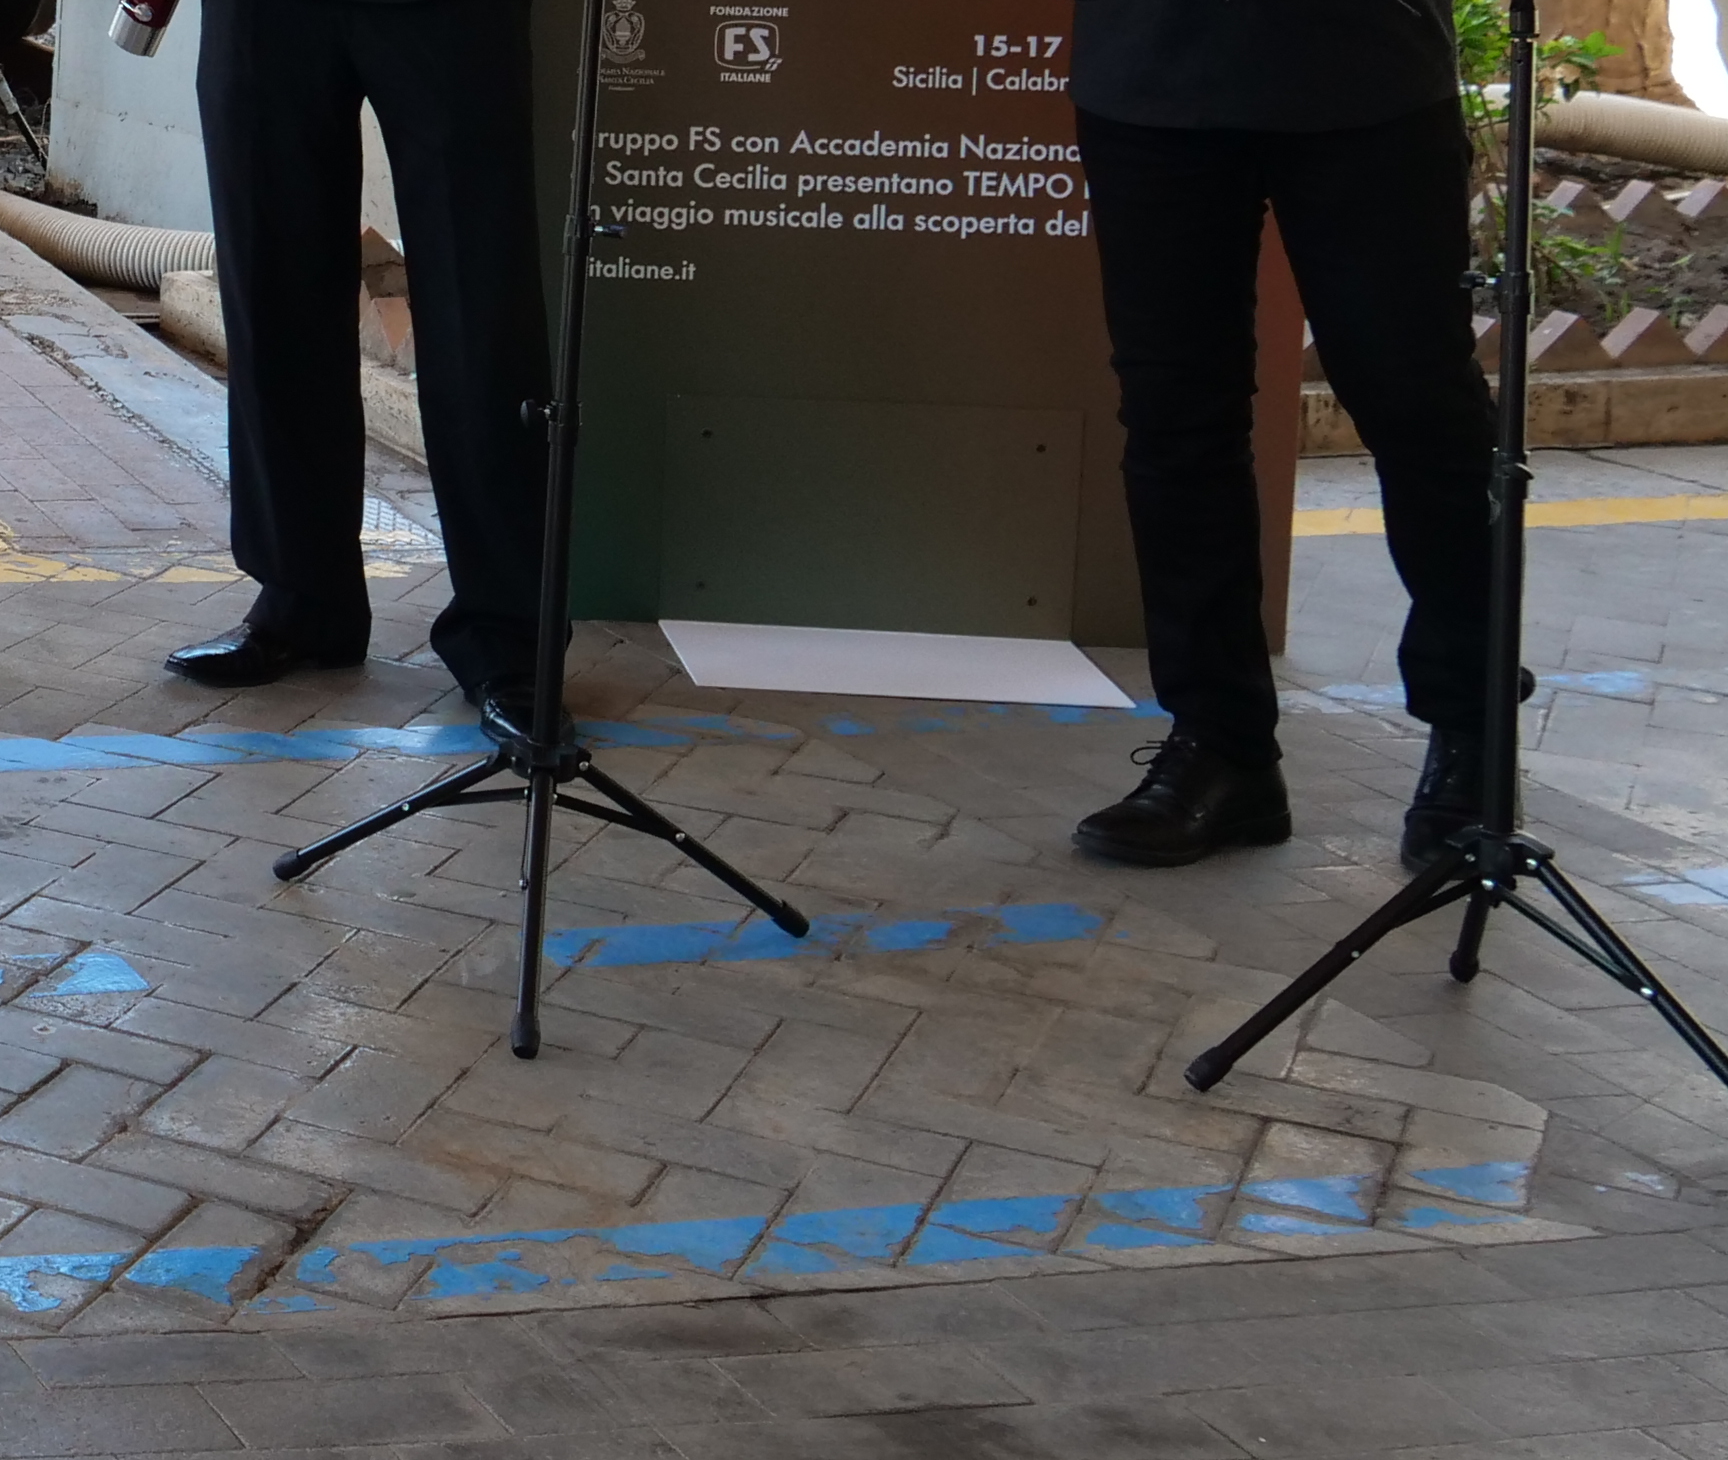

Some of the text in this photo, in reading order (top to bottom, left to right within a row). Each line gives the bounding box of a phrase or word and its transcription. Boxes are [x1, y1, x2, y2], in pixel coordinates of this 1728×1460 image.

[709, 5, 790, 18] FONDAZIONE
[724, 26, 771, 62] FS
[973, 34, 1063, 59] 15-17
[720, 72, 772, 83] ITALIANE
[892, 66, 963, 90] Sicilia
[985, 67, 1070, 92] Calabr
[572, 126, 1082, 163] ruppo FS con Accademia Naziona
[604, 160, 684, 188] Santa
[693, 163, 789, 191] Cecilia
[797, 169, 954, 198] presentano
[963, 171, 1074, 200] TEMPO
[610, 198, 714, 231] viaggio
[724, 202, 844, 230] musicale
[852, 205, 905, 232] alla
[913, 212, 1035, 241] scoperta
[588, 255, 697, 281] italiane.it
